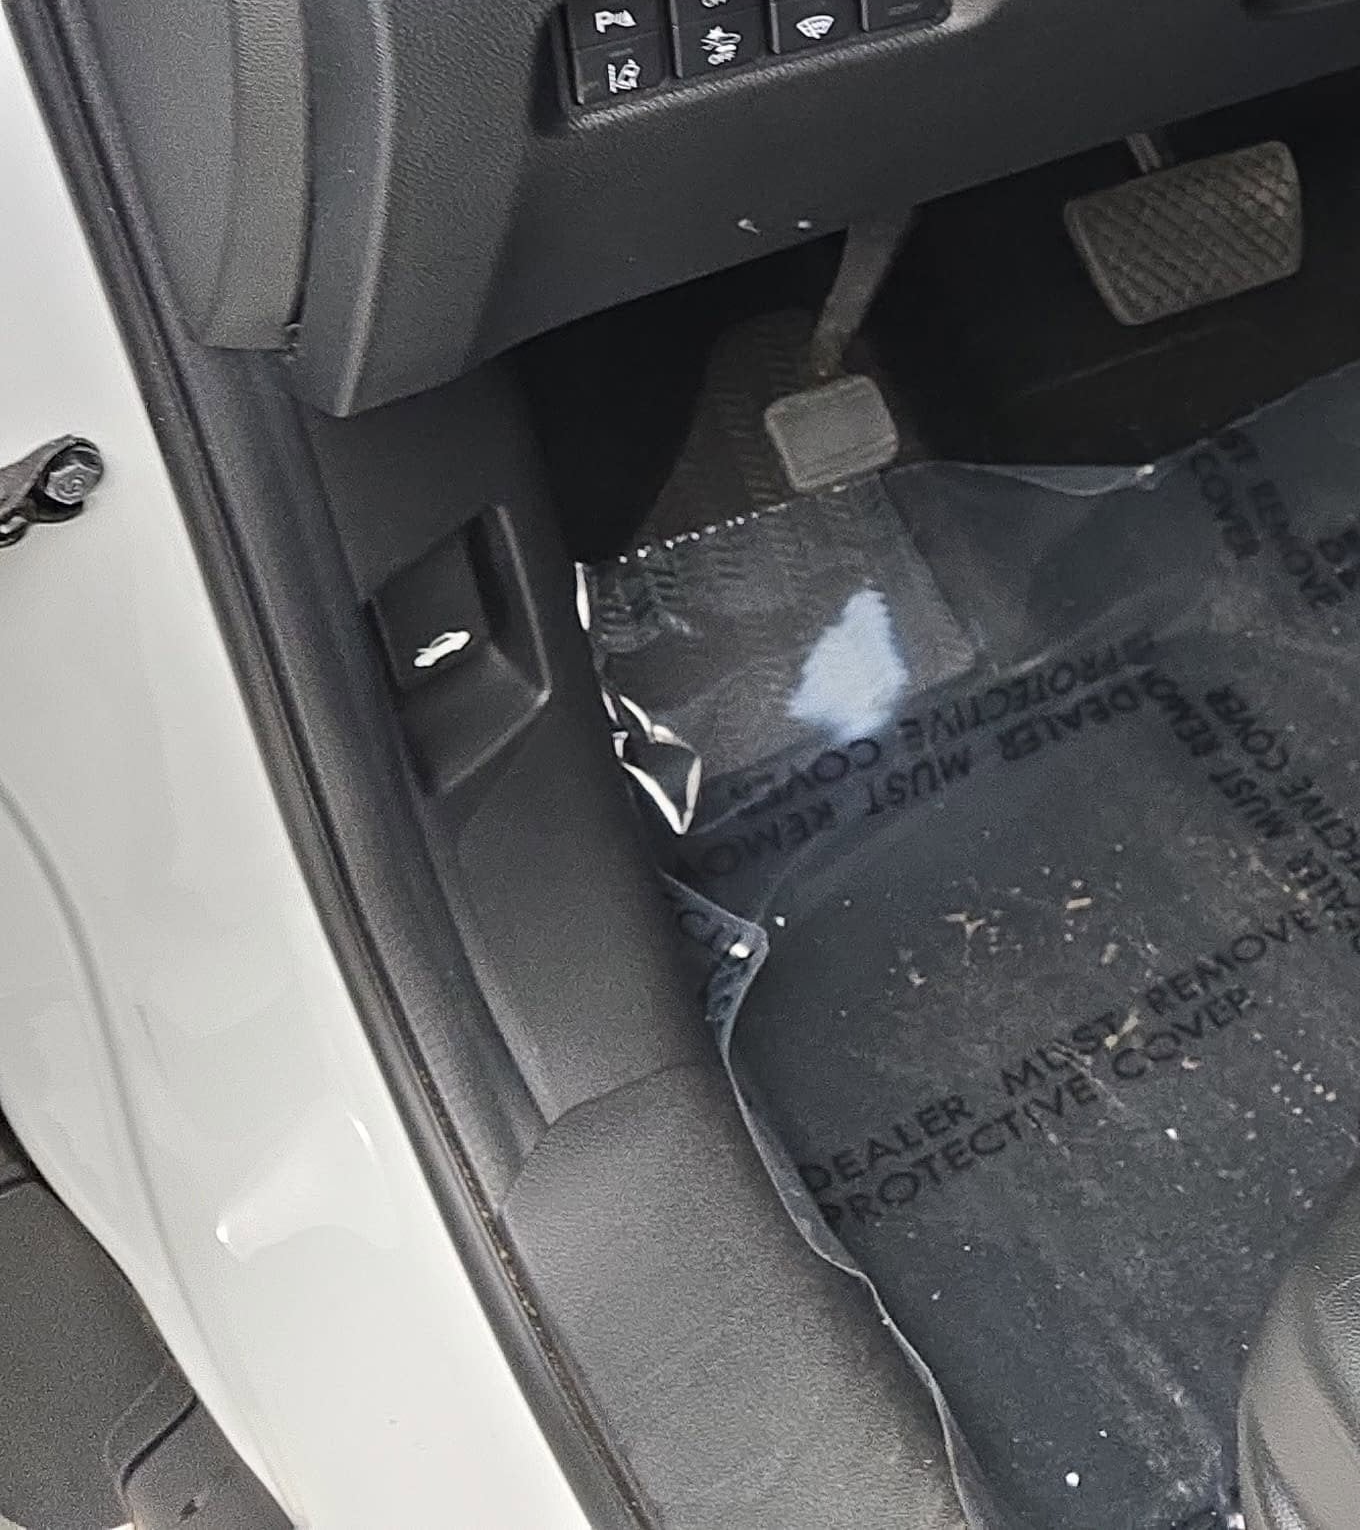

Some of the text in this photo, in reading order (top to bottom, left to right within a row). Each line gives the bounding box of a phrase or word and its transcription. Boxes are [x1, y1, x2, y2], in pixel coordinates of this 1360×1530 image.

[1190, 451, 1262, 561] COVER
[996, 683, 1140, 762] DEALER
[1205, 684, 1291, 773] COVER
[864, 743, 973, 817] MUST
[1207, 767, 1297, 840] MUST
[800, 909, 1320, 1194] DEALER MUST REMOVE
[819, 984, 1256, 1233] PROTECTIVE COVER
